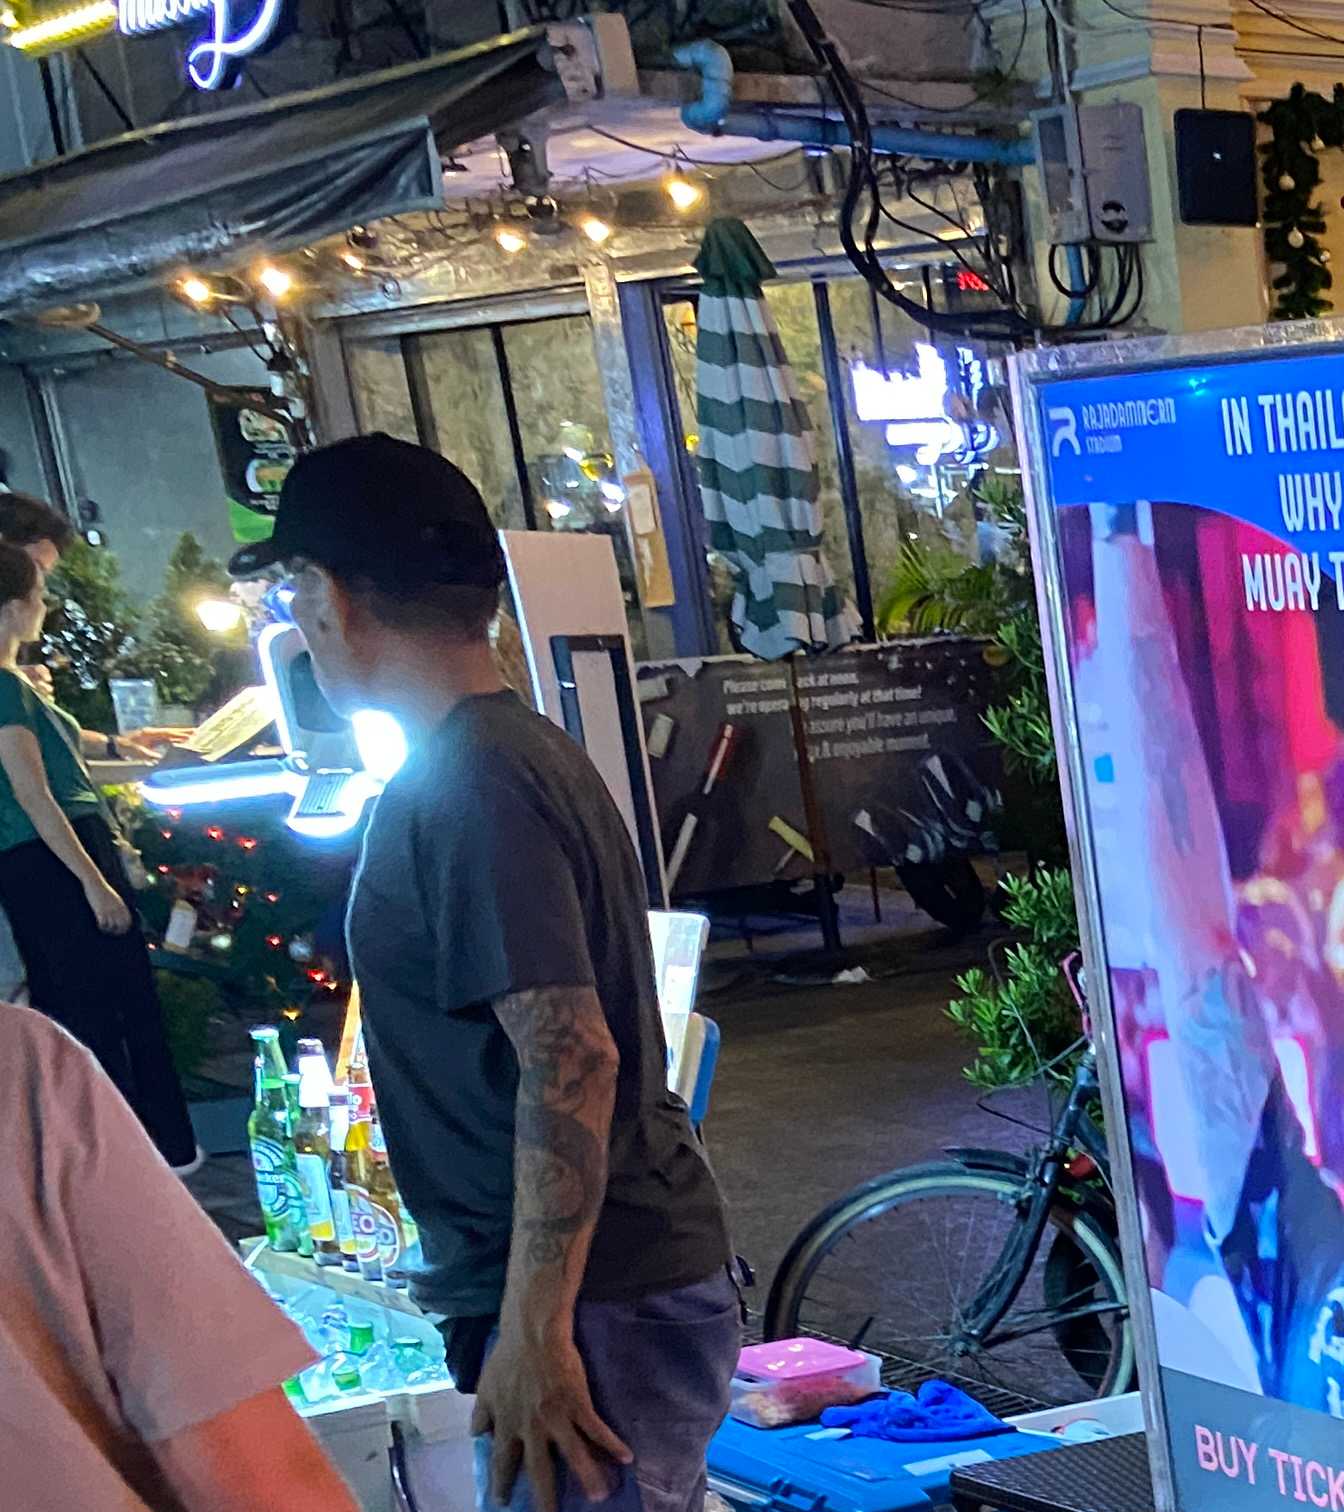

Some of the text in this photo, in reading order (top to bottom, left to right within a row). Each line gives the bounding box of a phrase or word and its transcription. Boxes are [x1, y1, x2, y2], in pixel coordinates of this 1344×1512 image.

[1221, 397, 1252, 456] IN
[1279, 471, 1342, 531] WHY
[1242, 552, 1321, 611] MUAY
[1194, 1424, 1258, 1485] BUY
